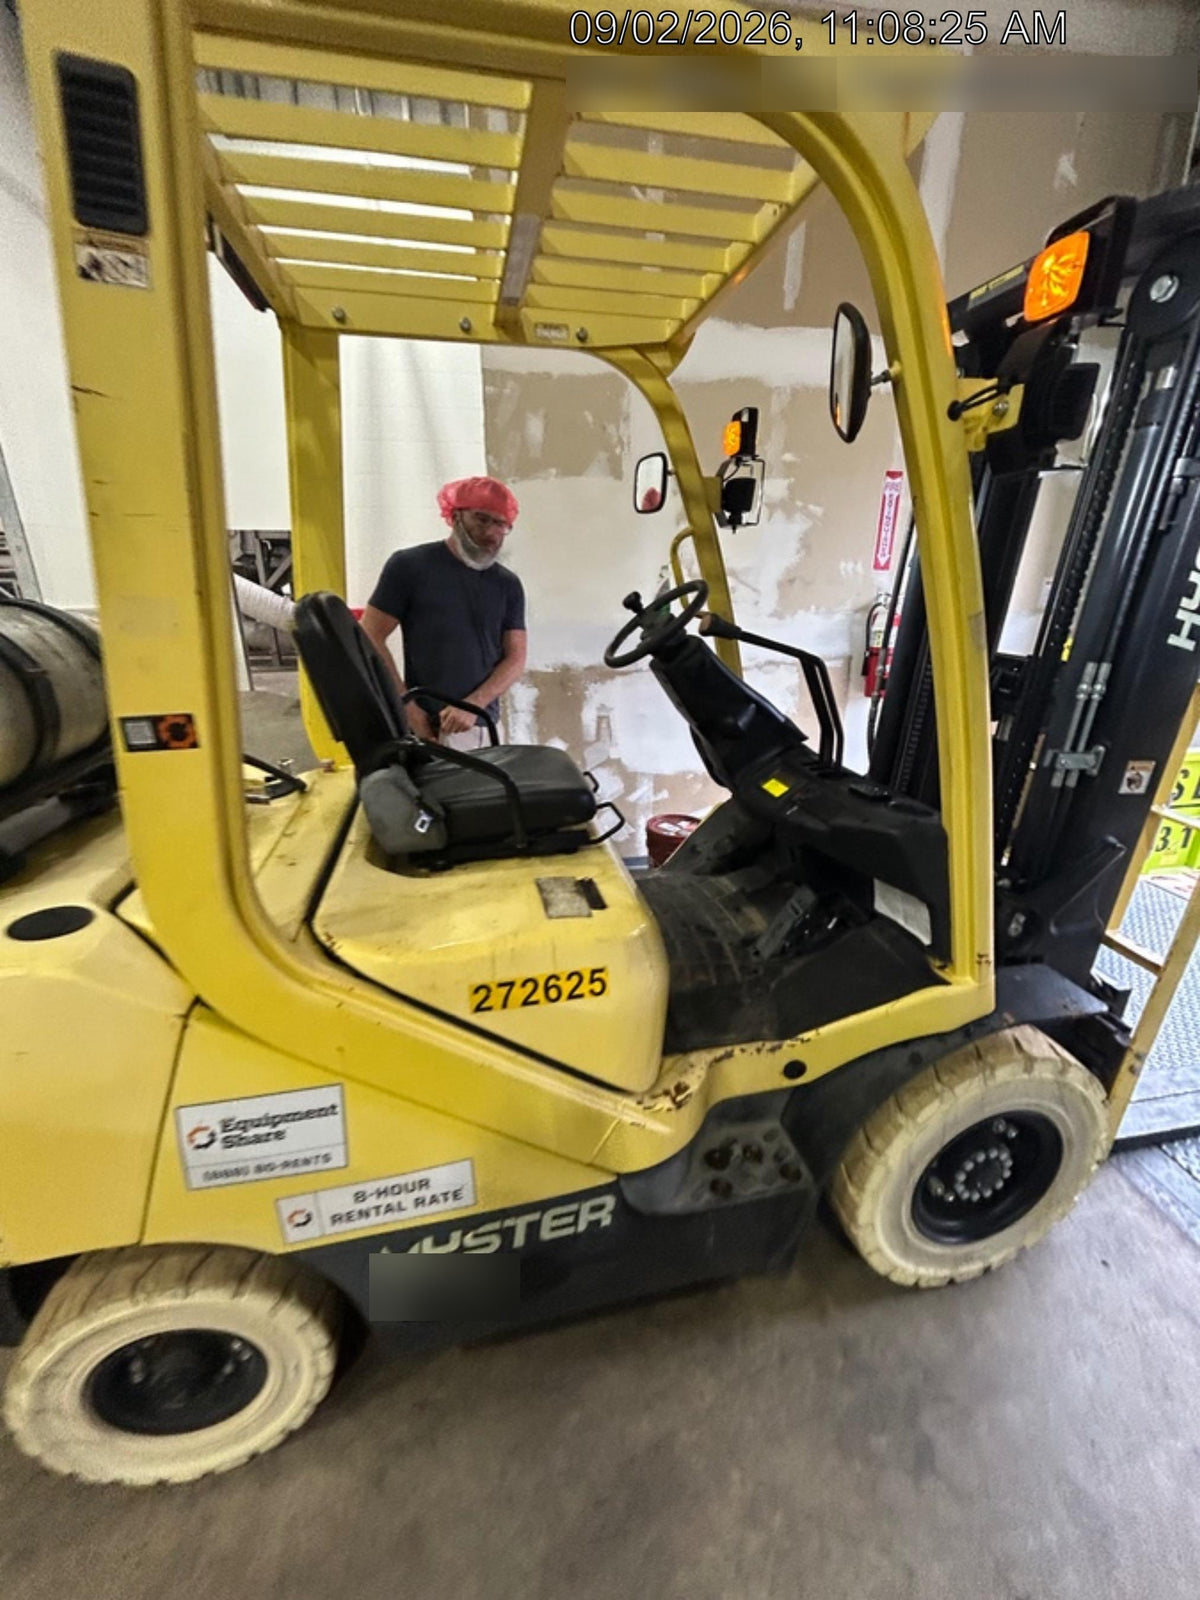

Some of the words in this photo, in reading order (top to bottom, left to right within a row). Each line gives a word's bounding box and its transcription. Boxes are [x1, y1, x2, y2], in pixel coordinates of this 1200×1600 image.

[1166, 545, 1200, 652] HY
[472, 966, 608, 1014] 272625
[220, 1103, 339, 1134] Equipment
[220, 1129, 287, 1150] Share
[330, 1200, 407, 1227] RENTAL
[413, 1188, 464, 1209] RATE
[353, 1177, 431, 1203] 8-HOUR
